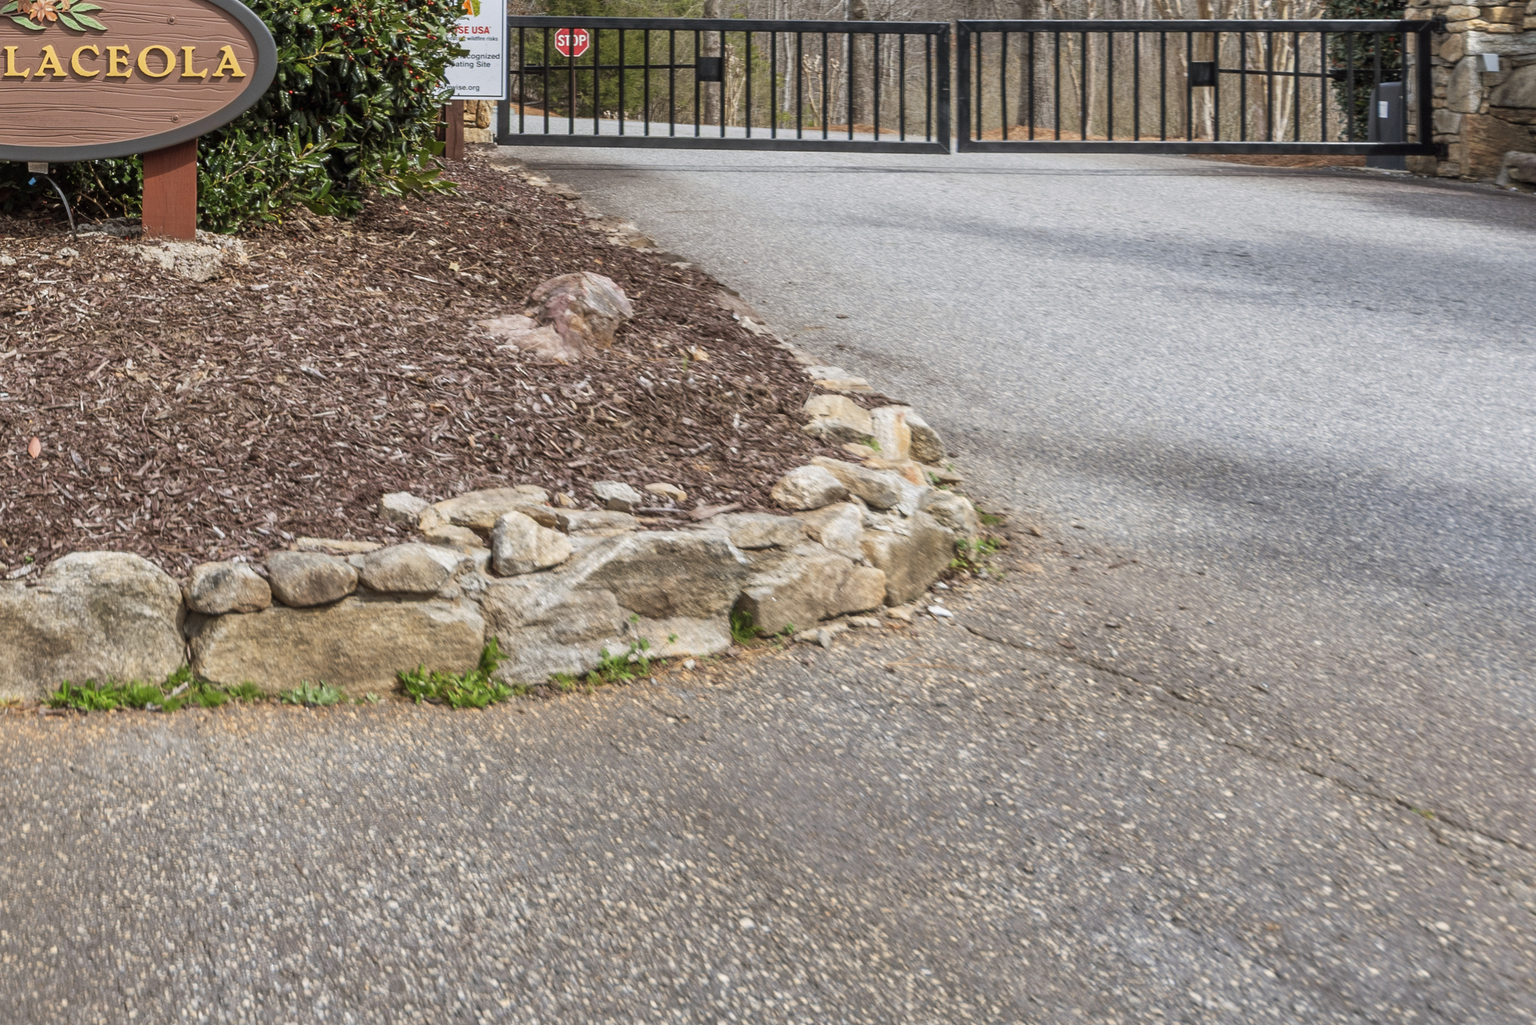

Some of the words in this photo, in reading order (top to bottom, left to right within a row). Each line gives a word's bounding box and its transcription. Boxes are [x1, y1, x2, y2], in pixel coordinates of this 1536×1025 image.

[471, 26, 490, 34] USA
[557, 34, 586, 47] STOP
[3, 44, 247, 78] LACEOLA
